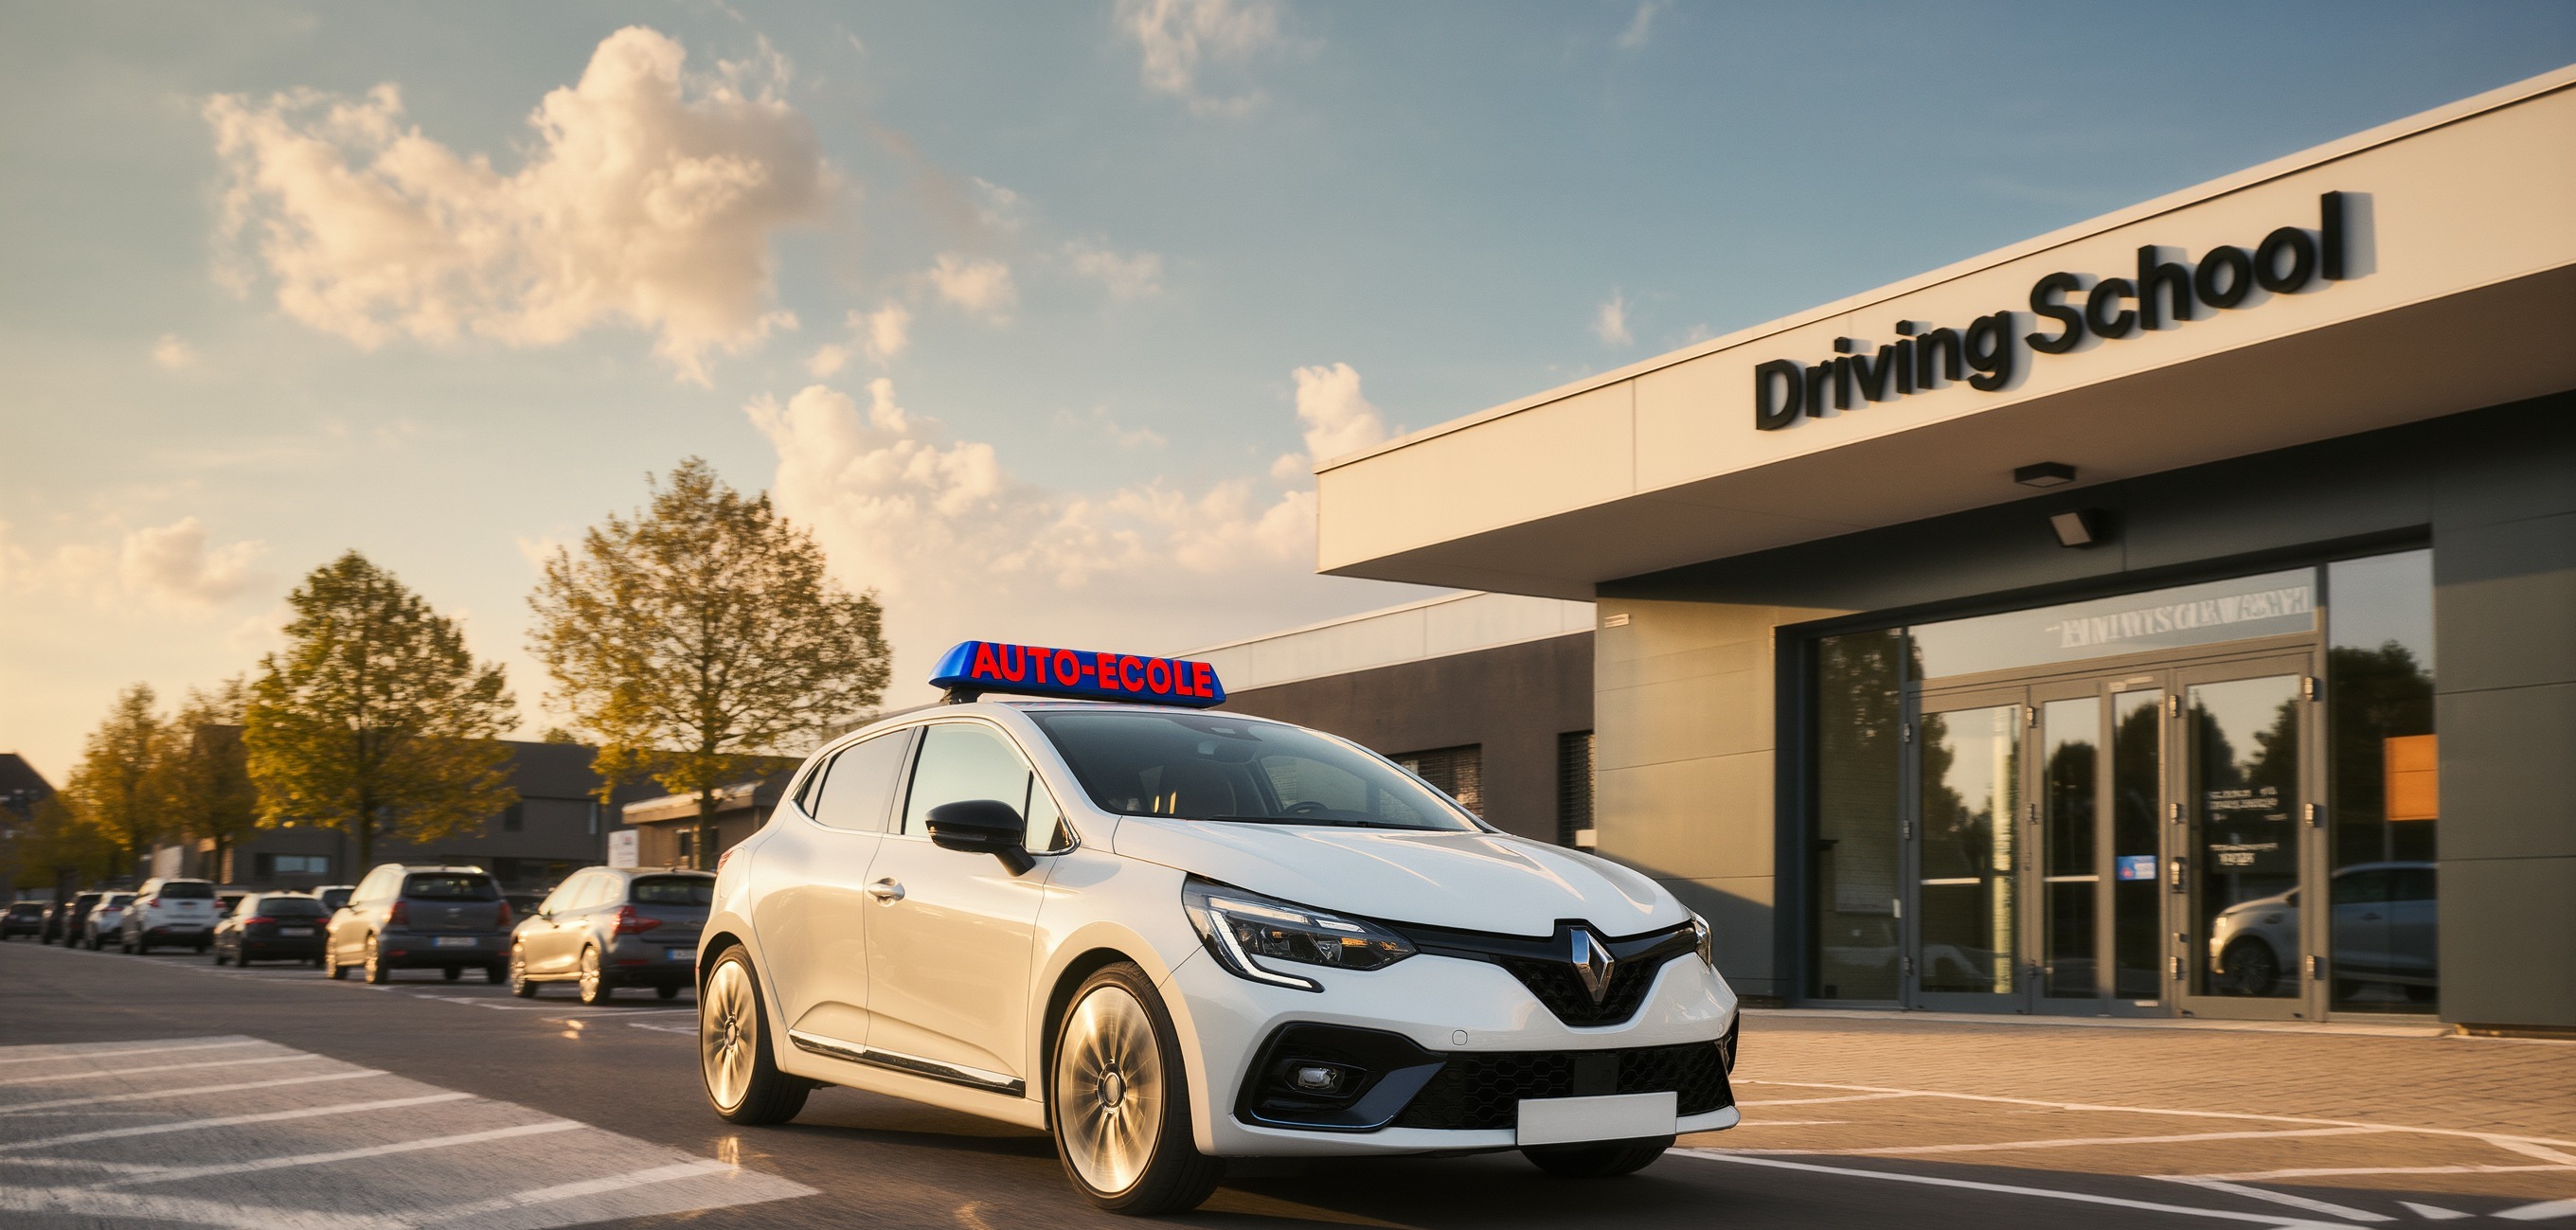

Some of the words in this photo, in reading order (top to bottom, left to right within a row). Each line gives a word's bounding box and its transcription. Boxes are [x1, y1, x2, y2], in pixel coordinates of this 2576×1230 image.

[1755, 311, 2013, 430] Driving
[2025, 190, 2343, 354] School
[971, 642, 1213, 698] AUTO-ECOLE
